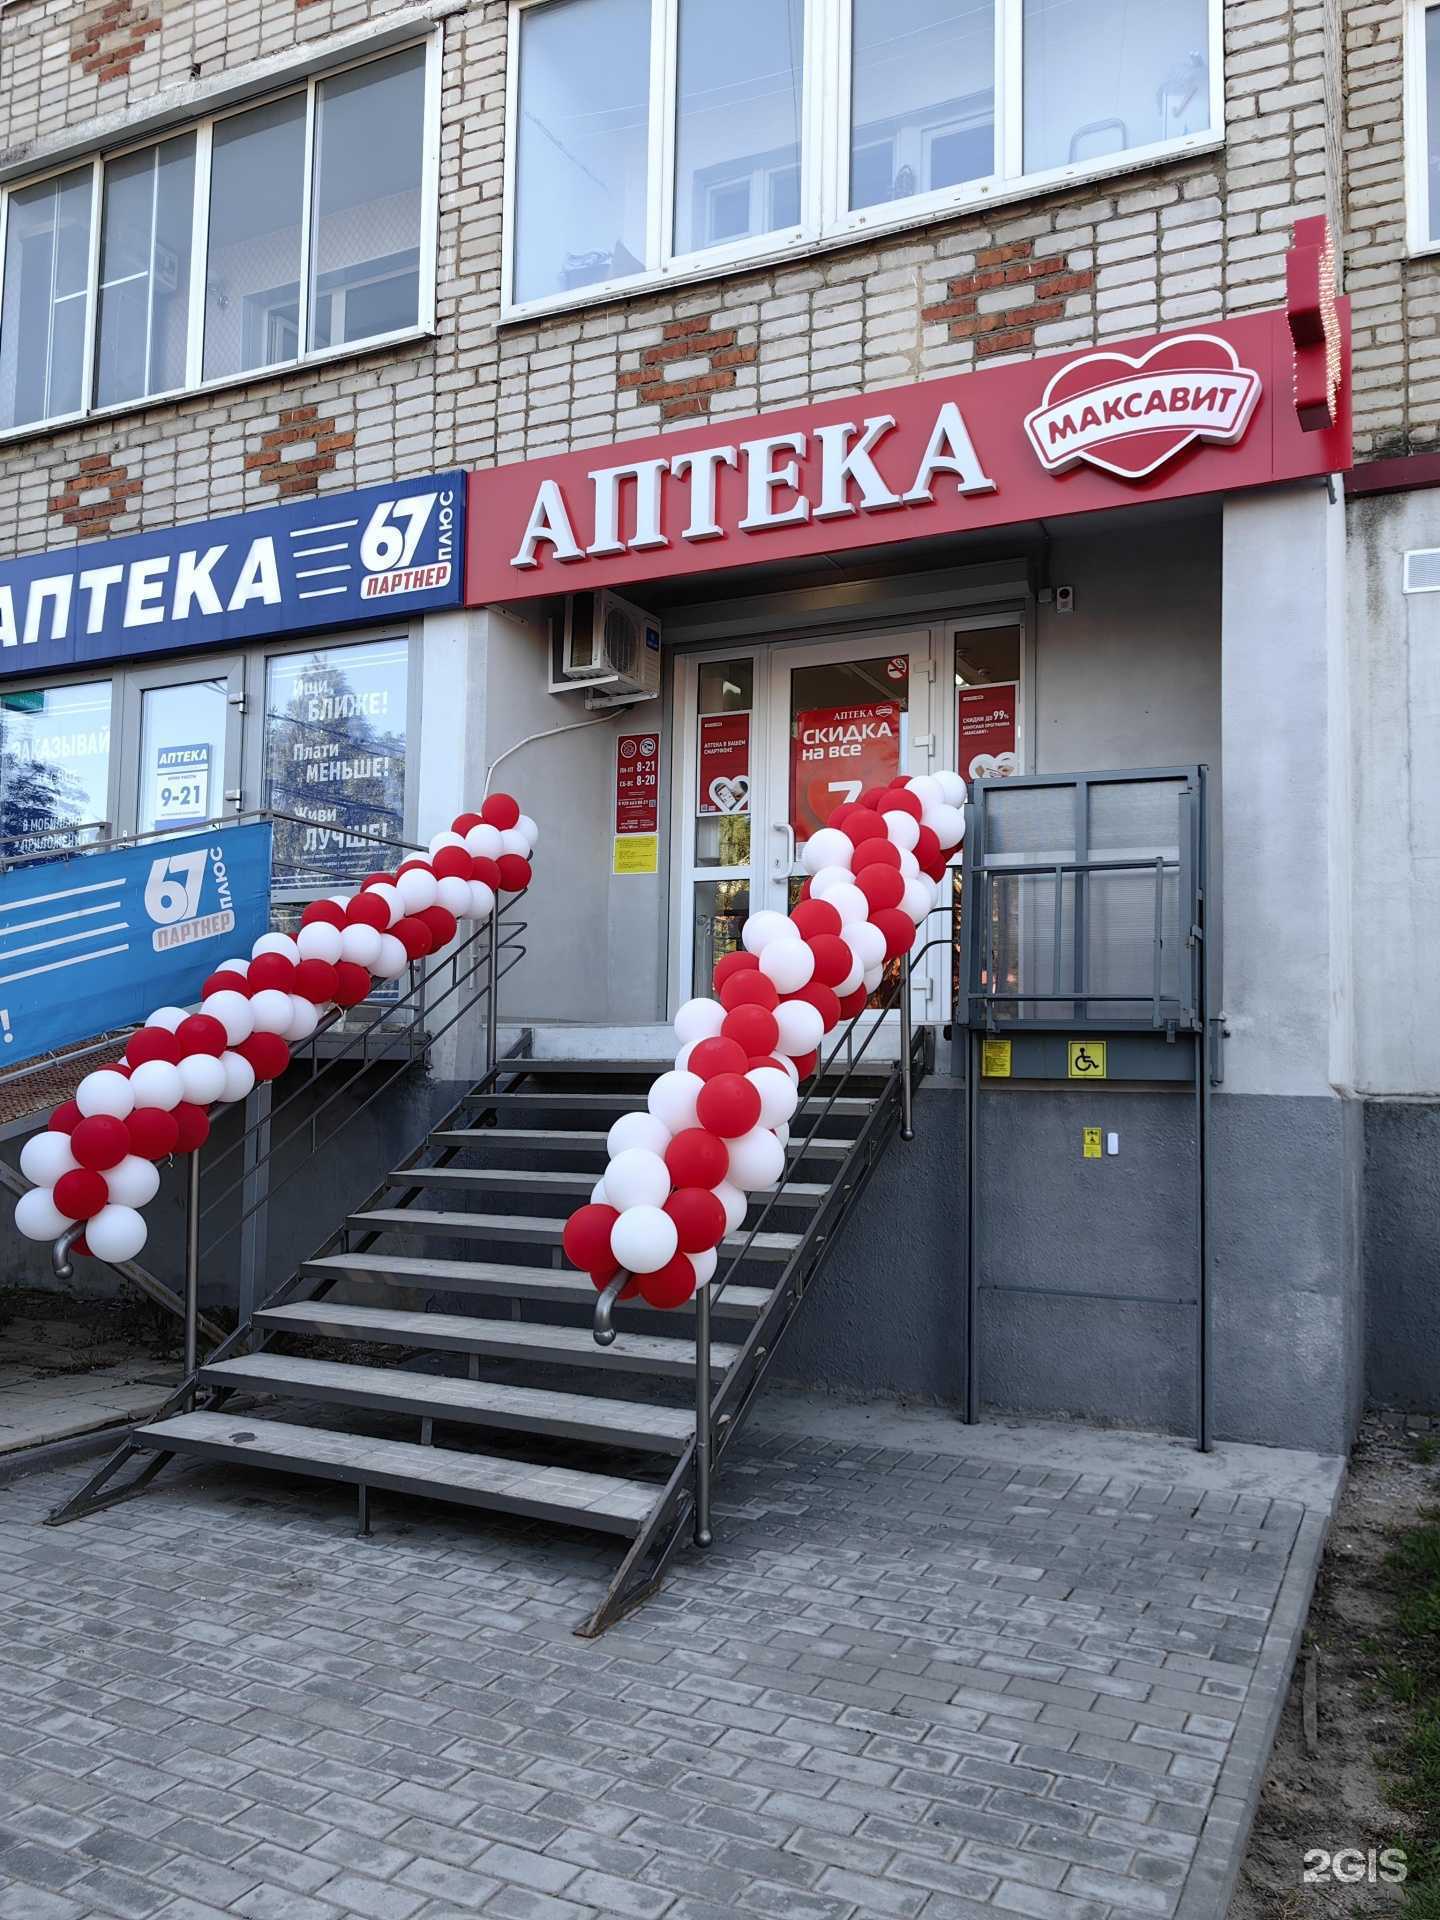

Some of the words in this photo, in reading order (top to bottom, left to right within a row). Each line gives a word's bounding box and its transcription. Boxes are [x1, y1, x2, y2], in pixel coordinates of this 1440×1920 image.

[1047, 386, 1237, 445] МАКСАВИТ
[510, 401, 996, 569] АПТЕКА
[360, 492, 439, 572] 67
[438, 490, 454, 560] ПЛЮС
[366, 565, 448, 597] ПАРТНЕР
[307, 689, 389, 722] БЛИЖЕ!
[833, 709, 874, 720] АПТЕКА
[803, 722, 893, 744] СКИДКА
[159, 748, 208, 764] АПТЕКА
[293, 743, 340, 760] Плати
[802, 749, 824, 760] на
[306, 757, 390, 783] МЕНЬШЕ!
[636, 761, 656, 772] 8-21
[636, 774, 656, 786] 8-20
[161, 785, 201, 807] 9-21
[294, 805, 337, 823] Живи
[303, 823, 388, 852] ЛУЧШЕ!
[144, 848, 208, 925] 67
[210, 846, 233, 909] ПЛЮС
[156, 911, 231, 949] ПАРТНЕР
